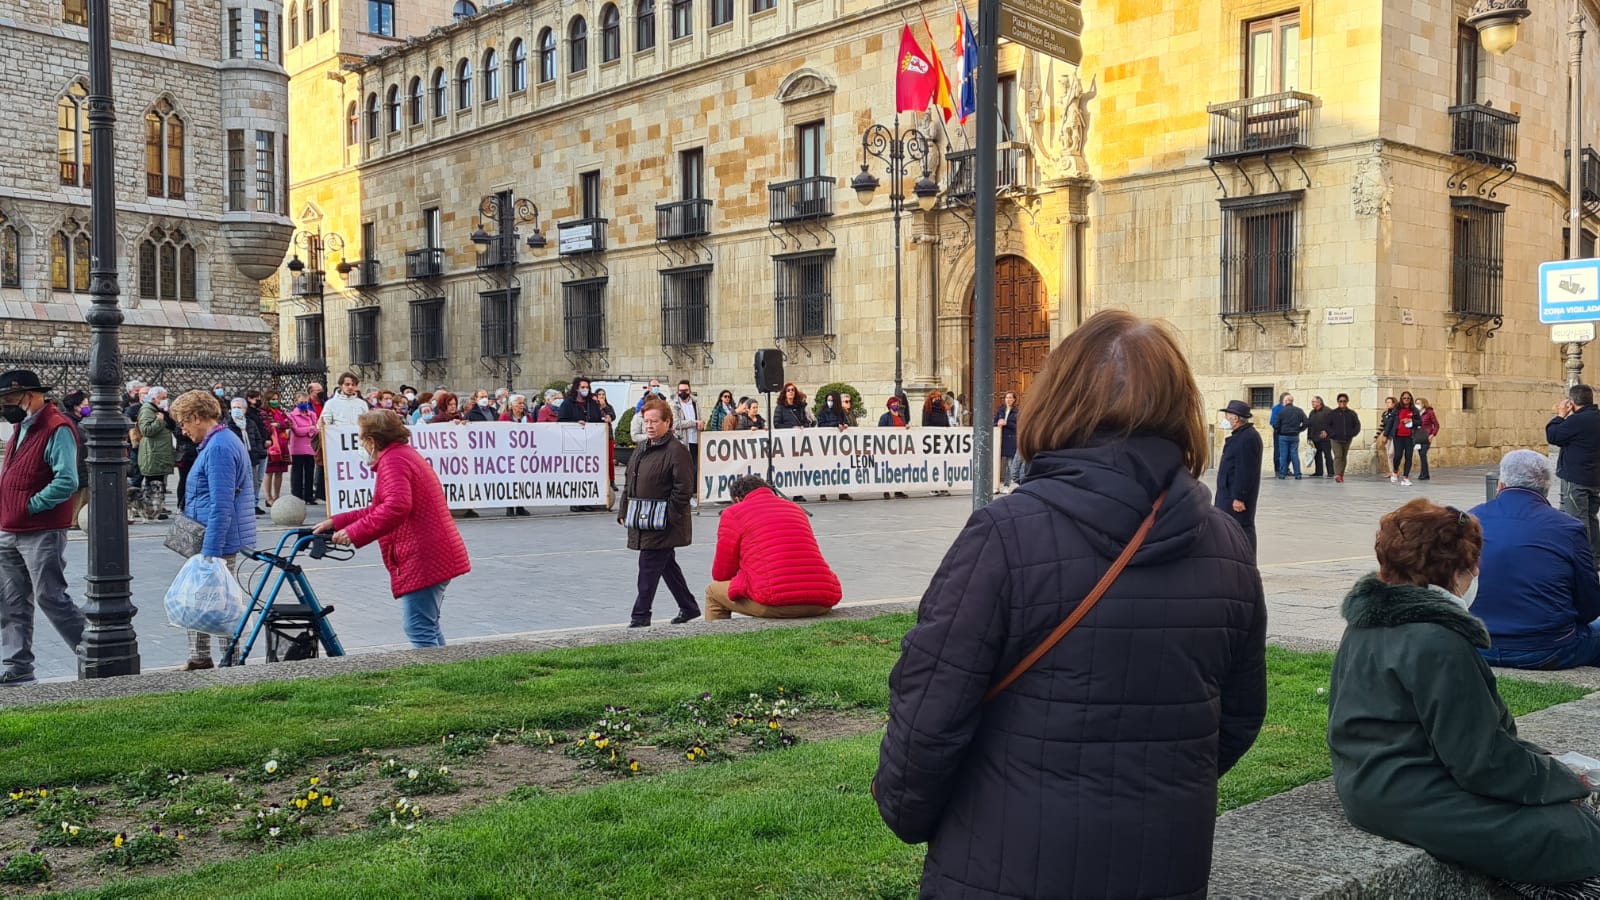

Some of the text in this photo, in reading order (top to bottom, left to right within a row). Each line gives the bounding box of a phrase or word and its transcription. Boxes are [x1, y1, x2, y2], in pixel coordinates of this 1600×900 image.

[1012, 15, 1056, 40] Plaza Mayor de la
[410, 431, 458, 450] LUNES
[468, 430, 496, 449] SIN
[509, 430, 537, 449] SOL
[706, 434, 974, 462] CONTRA LA VIOLENCIA SEXIS
[336, 461, 354, 480] EL
[440, 457, 469, 476] NOS
[474, 456, 516, 475] HACE
[520, 450, 600, 474] CÓMPLICES
[469, 482, 481, 502] LA
[484, 481, 542, 500] VIOLENCIA
[546, 480, 600, 499] MACHISTA
[704, 475, 713, 499] y
[855, 467, 870, 484] en
[874, 460, 928, 484] Libertad
[932, 466, 939, 482] e
[944, 459, 973, 487] Igual
